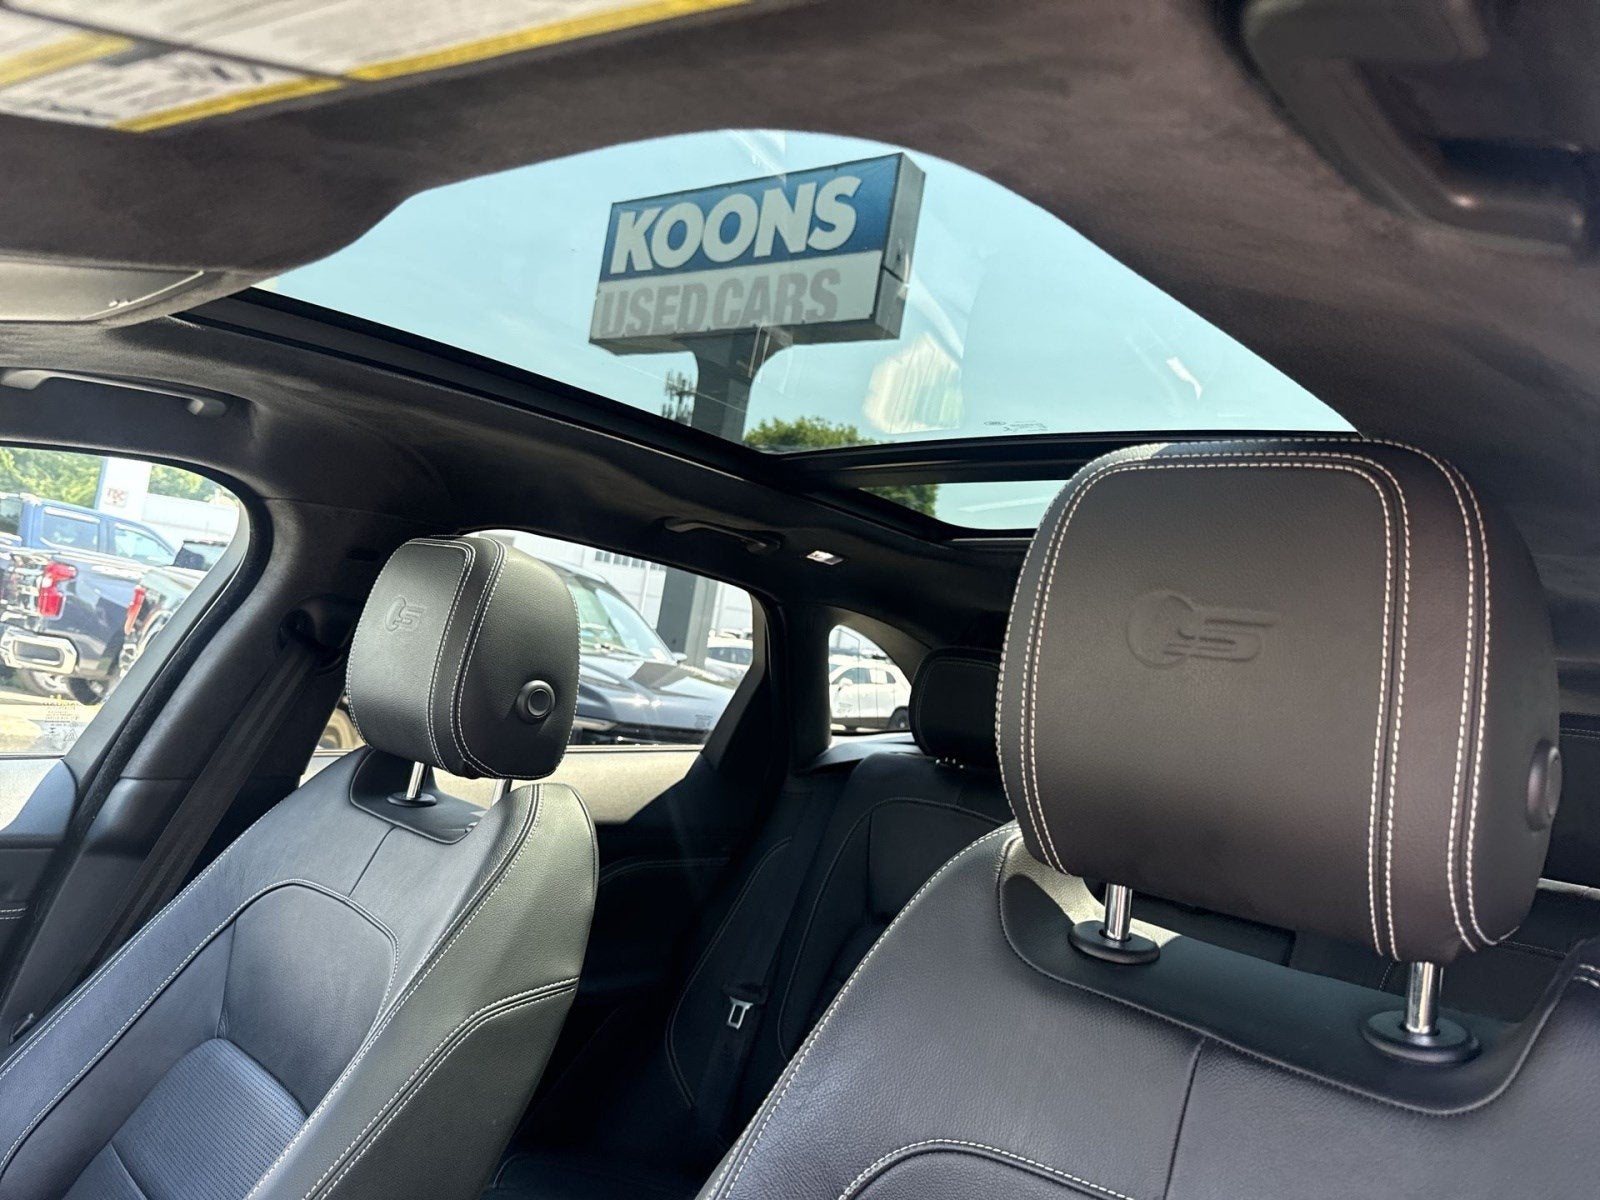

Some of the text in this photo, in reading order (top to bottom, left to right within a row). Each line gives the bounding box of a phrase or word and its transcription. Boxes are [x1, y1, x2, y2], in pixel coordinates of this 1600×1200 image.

[610, 175, 862, 275] KOONS
[600, 268, 841, 337] USED CARS
